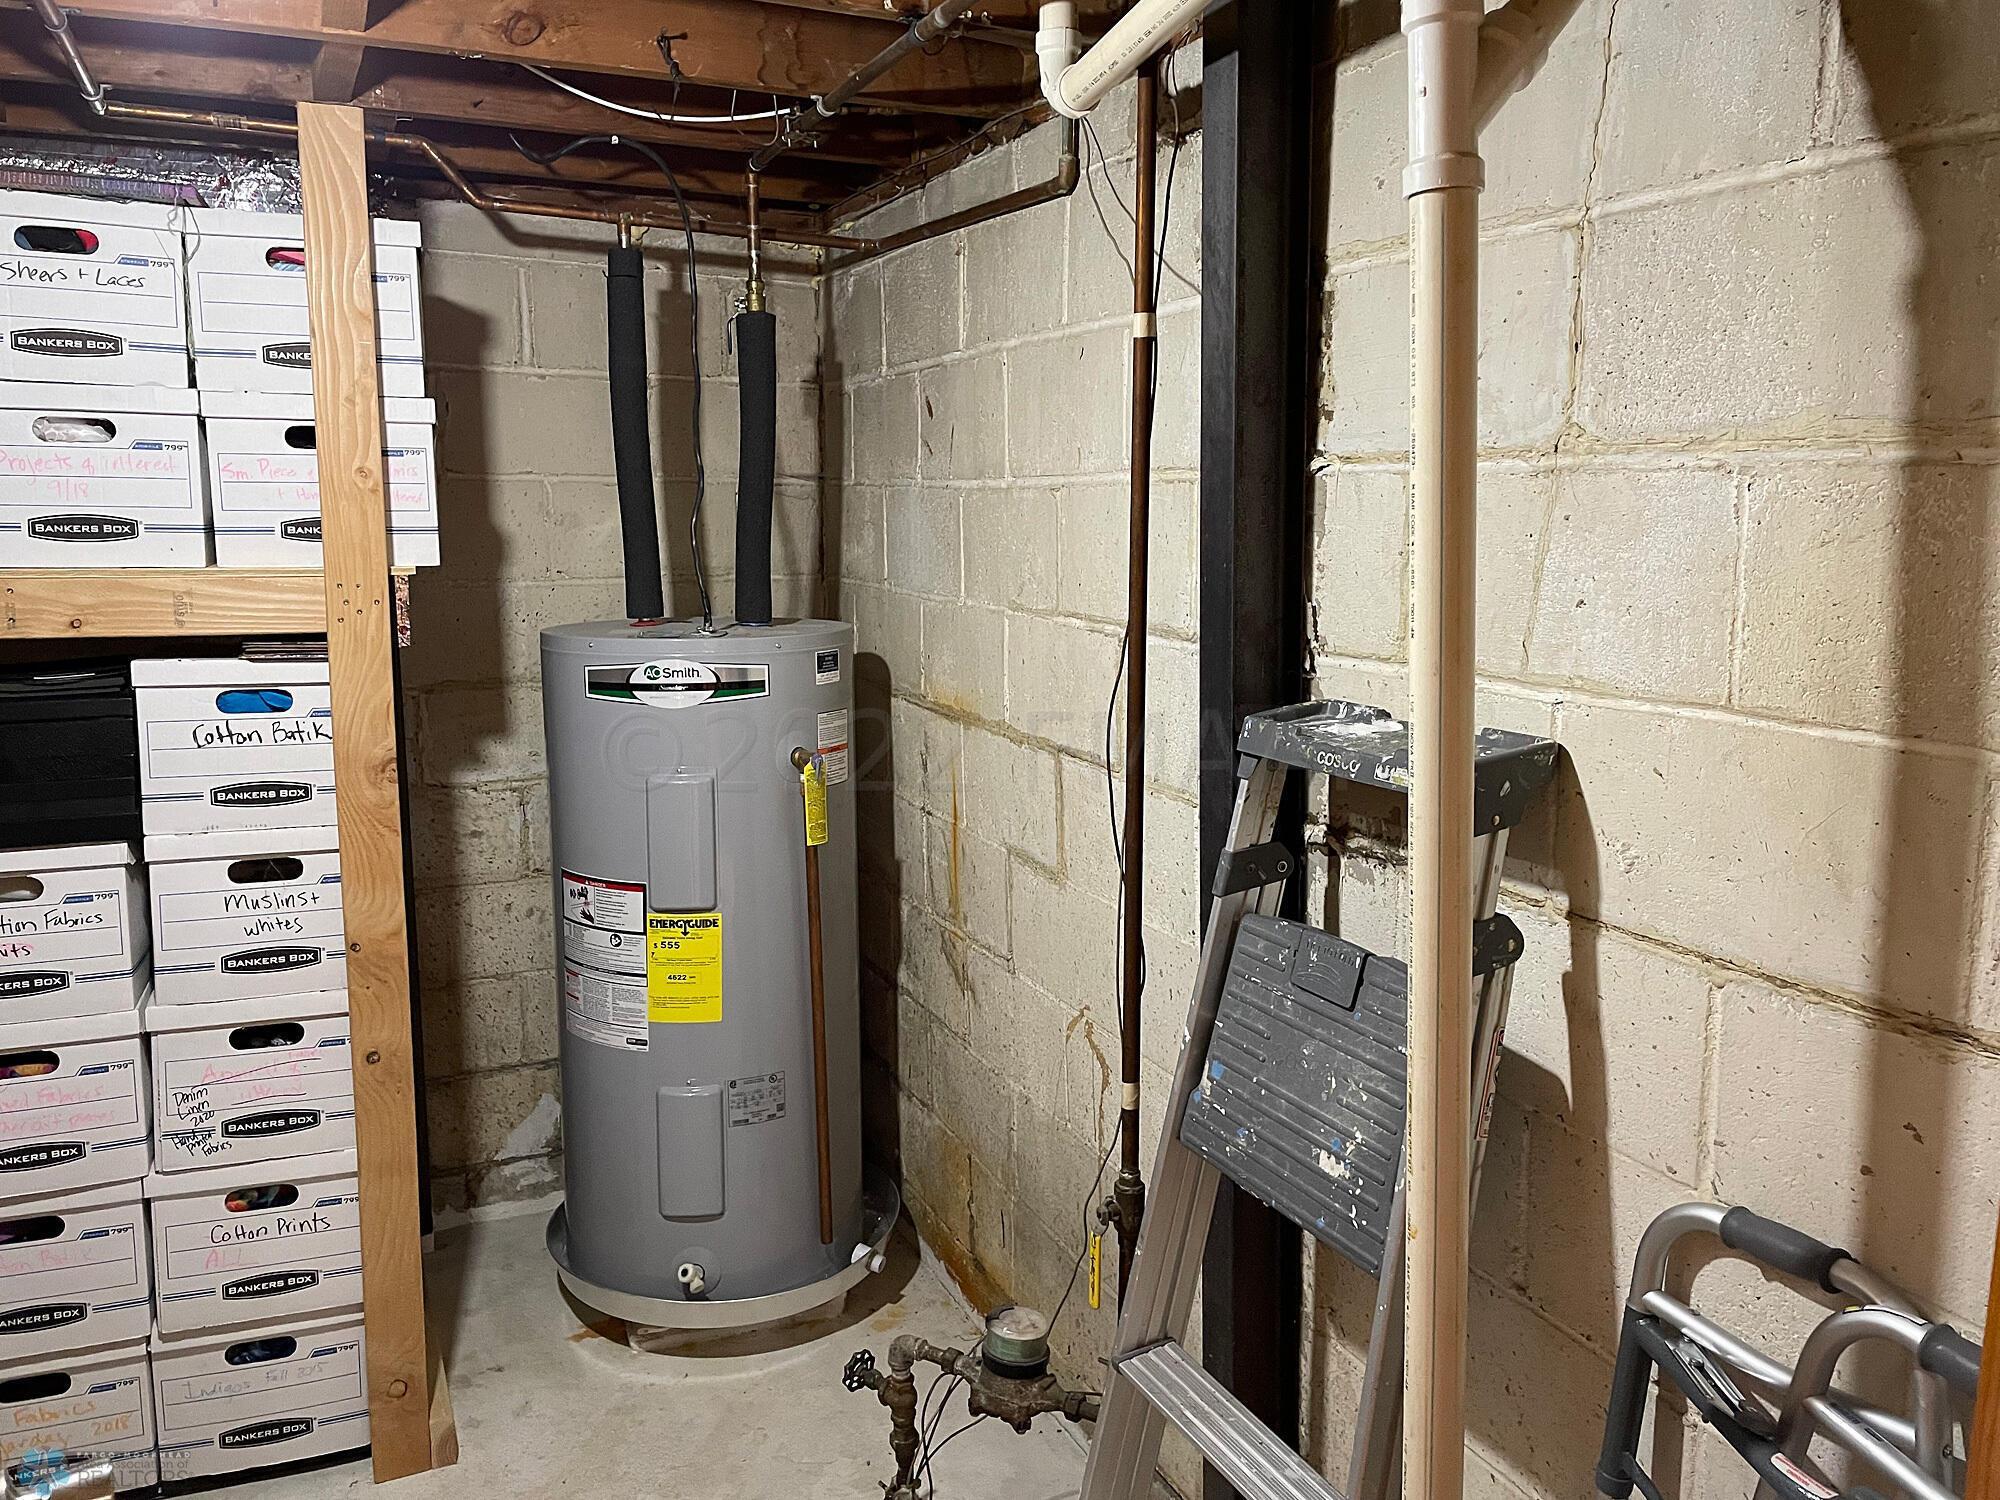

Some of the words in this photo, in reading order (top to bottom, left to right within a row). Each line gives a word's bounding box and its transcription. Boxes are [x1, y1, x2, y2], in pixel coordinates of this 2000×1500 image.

[95, 268, 146, 288] Laces
[17, 336, 83, 348] BANKERS
[86, 340, 116, 350] BOX
[269, 350, 312, 360] BANKE
[35, 523, 99, 533] BANKERS
[102, 524, 132, 534] BOX
[287, 525, 321, 535] BANK
[662, 667, 700, 679] Smith
[216, 790, 276, 801] BANKERS
[279, 788, 306, 798] BOX
[44, 908, 103, 930] Fabrics
[660, 941, 681, 949] 555
[227, 955, 286, 968] BANKERS
[289, 952, 315, 962] BOX
[0, 980, 30, 991] KERS
[34, 977, 62, 987] BOX
[228, 1119, 285, 1132] BANKERS
[288, 1115, 314, 1125] BOX
[0, 1152, 48, 1166] ANKERS
[51, 1147, 79, 1158] BOX
[210, 1224, 268, 1244] Cotton
[276, 1212, 331, 1236] Prints
[228, 1279, 285, 1295] BANKERS
[287, 1275, 313, 1285] BOX
[0, 1313, 50, 1327] ANKERS
[53, 1308, 80, 1319] BOX
[225, 1428, 280, 1444] BANKERS
[283, 1423, 307, 1434] BOX
